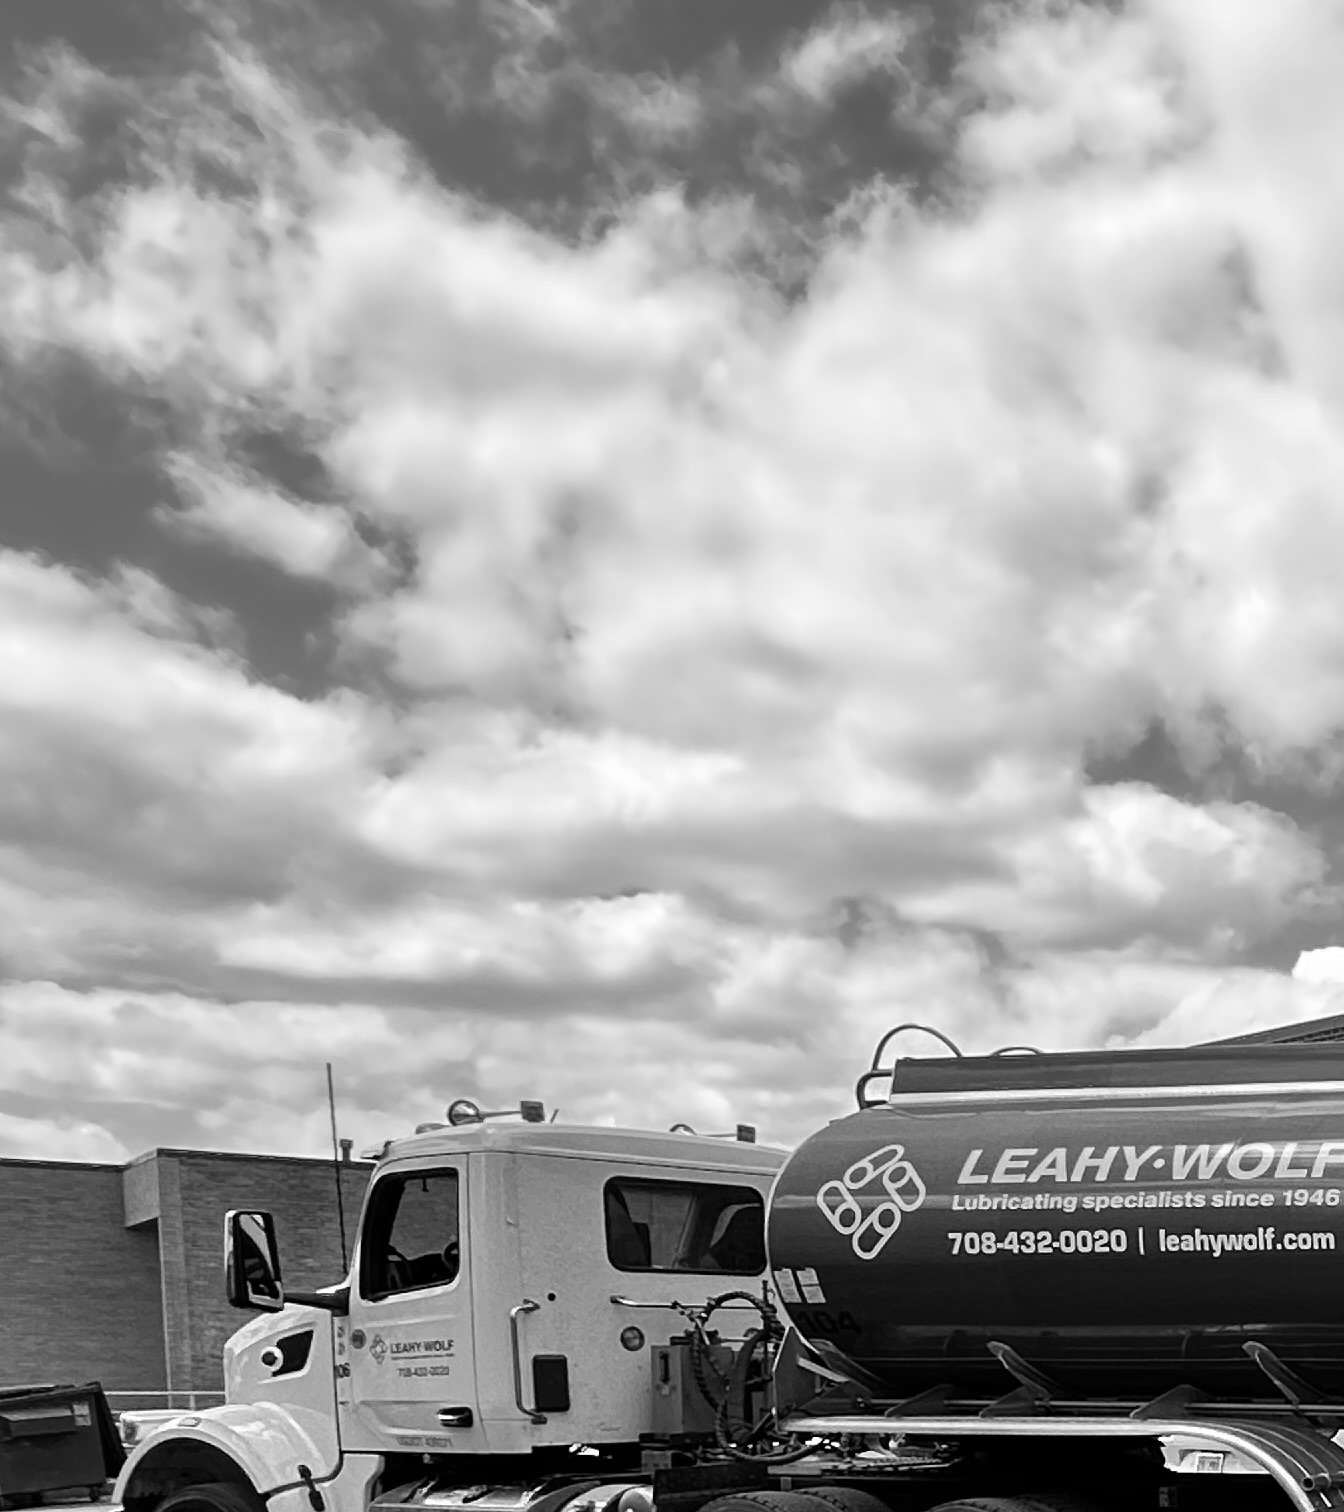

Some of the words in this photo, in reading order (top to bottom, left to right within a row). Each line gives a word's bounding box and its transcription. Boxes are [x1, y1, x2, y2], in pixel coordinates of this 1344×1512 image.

[952, 1193, 1078, 1213] Lubricating
[1082, 1191, 1206, 1212] specialists
[1211, 1190, 1275, 1208] since
[1283, 1188, 1341, 1206] 1946
[948, 1228, 1128, 1255] 708-432-0020
[1159, 1226, 1336, 1257] leahywolf.com
